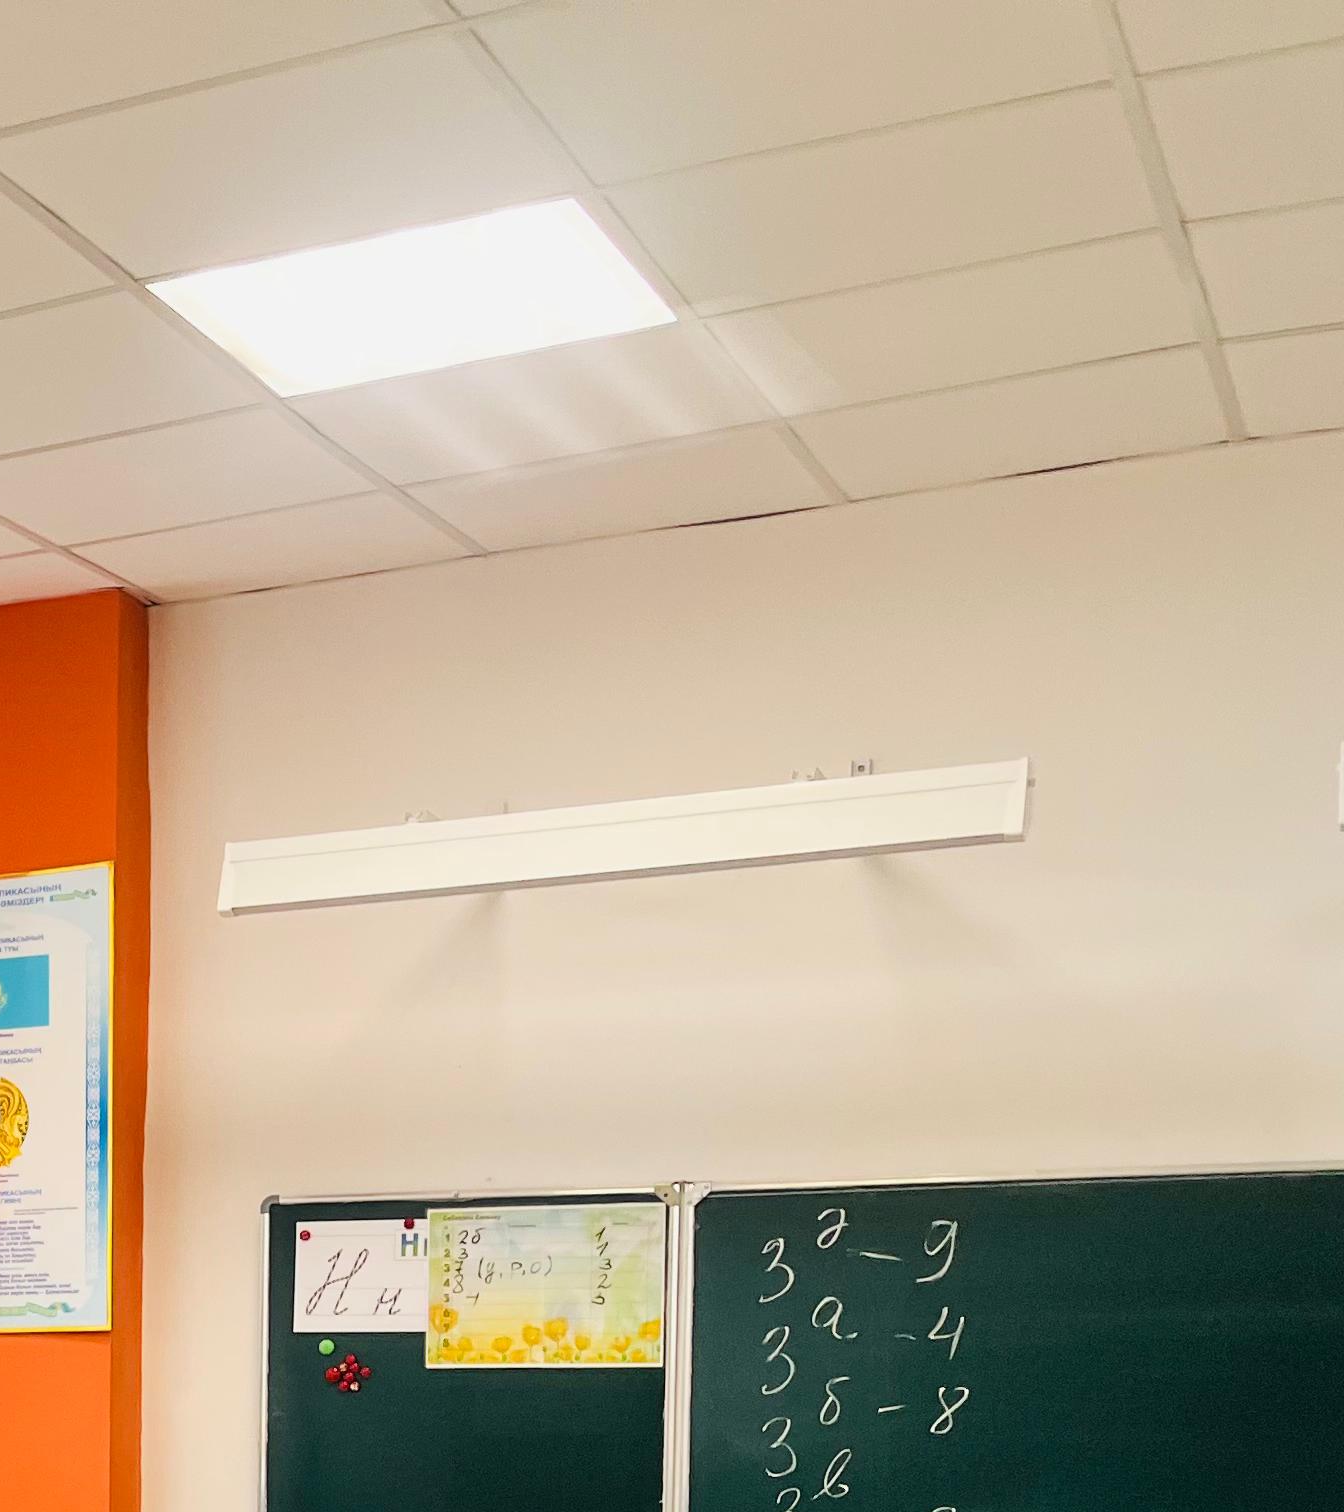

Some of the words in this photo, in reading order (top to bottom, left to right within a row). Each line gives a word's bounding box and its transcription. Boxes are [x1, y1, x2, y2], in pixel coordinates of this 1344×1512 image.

[915, 1219, 959, 1283] 9
[927, 1306, 965, 1361] 4
[929, 1386, 970, 1435] 8
